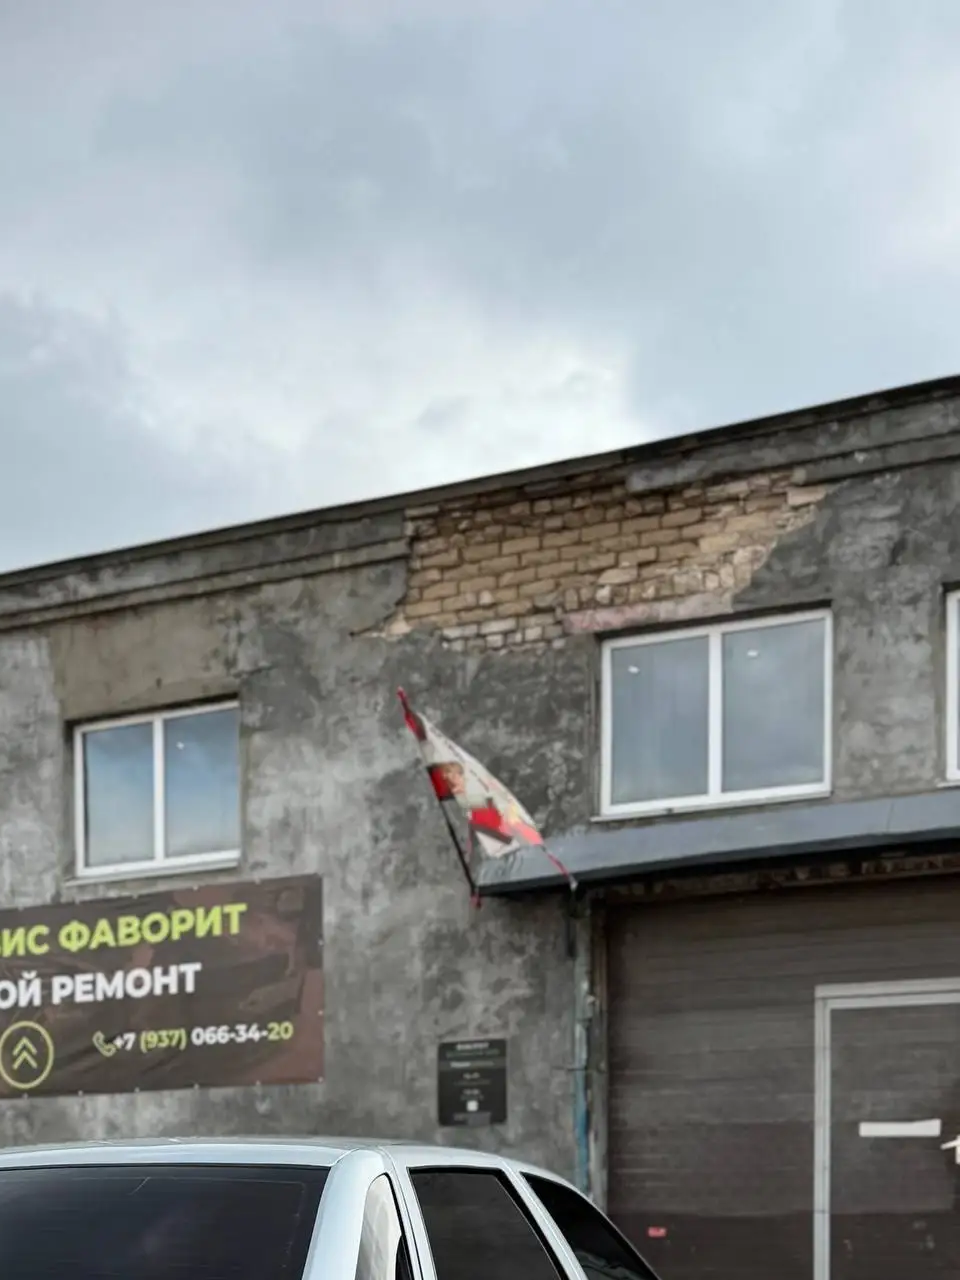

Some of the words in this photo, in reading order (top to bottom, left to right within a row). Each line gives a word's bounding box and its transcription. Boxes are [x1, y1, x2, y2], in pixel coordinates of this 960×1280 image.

[58, 903, 248, 952] ФАВОРИТ
[52, 963, 203, 1005] РЕМОНТ
[114, 1032, 137, 1050] +7
[140, 1028, 187, 1053] (937)
[191, 1021, 294, 1046] 066-34-20
